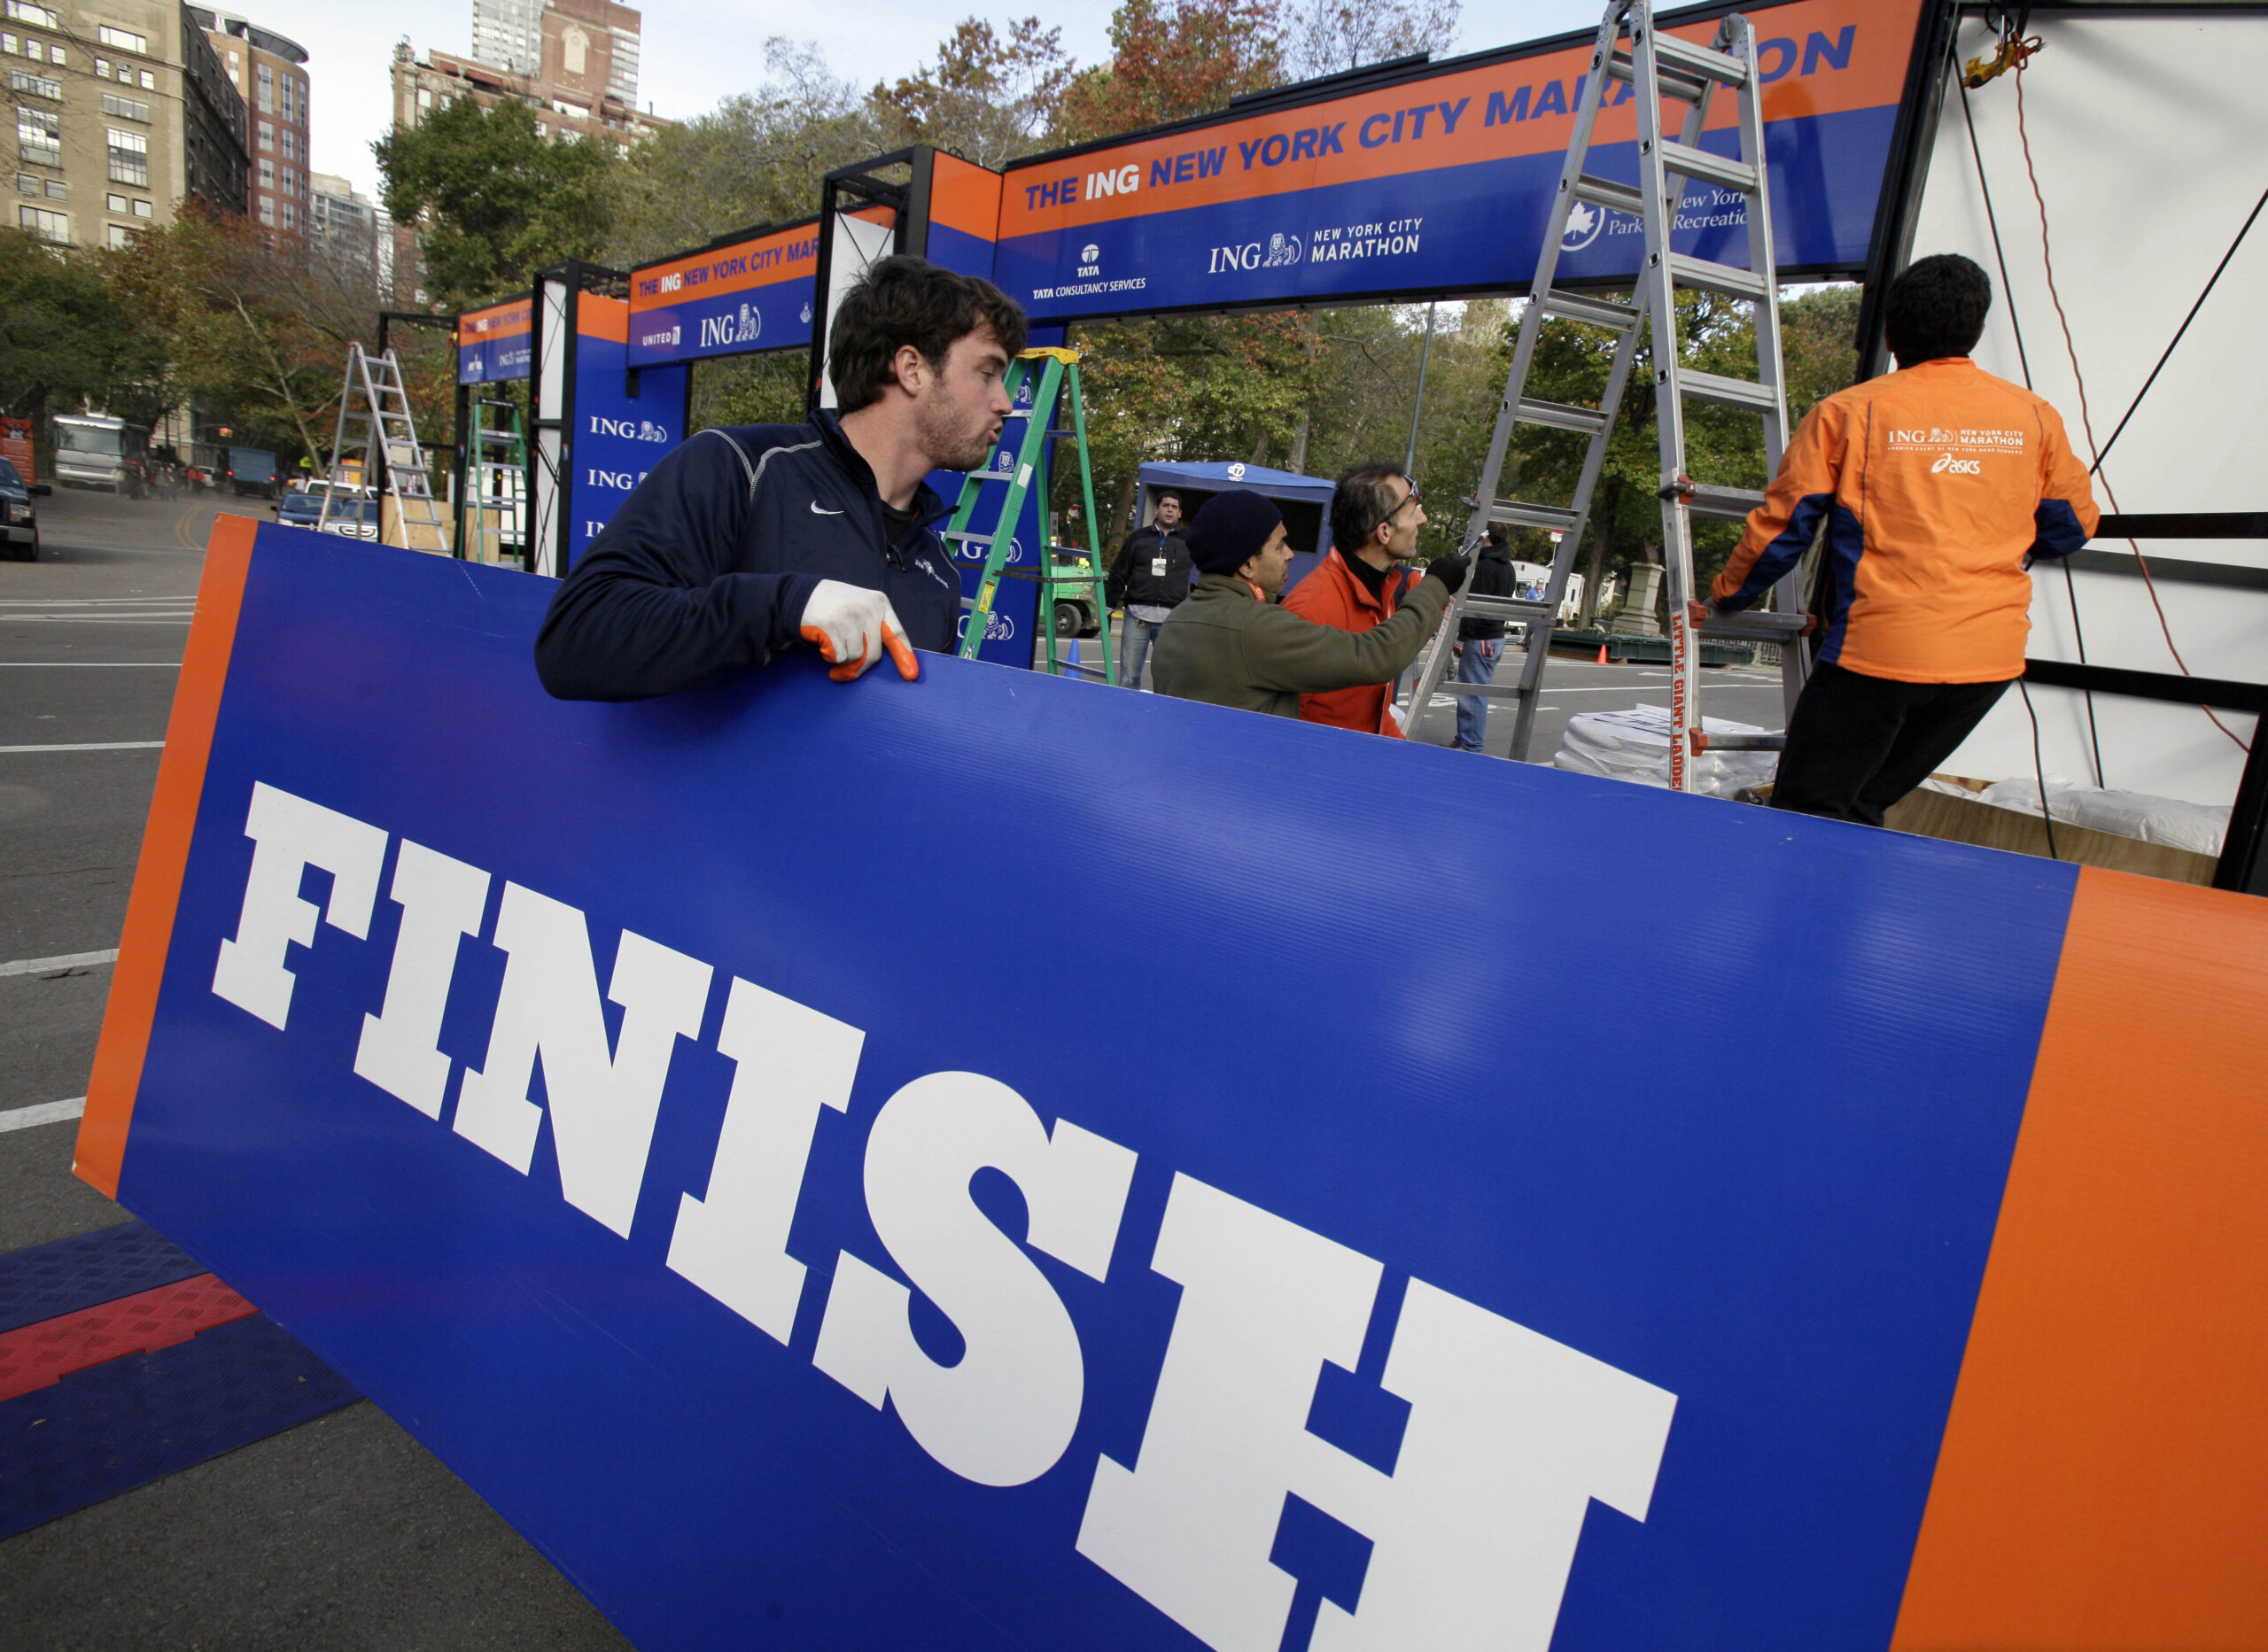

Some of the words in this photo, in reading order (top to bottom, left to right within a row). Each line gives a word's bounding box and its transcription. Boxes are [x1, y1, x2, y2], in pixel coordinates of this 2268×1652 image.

[1025, 177, 1078, 211] THE
[1085, 164, 1140, 201] ING
[1149, 145, 1227, 187] NEW
[1238, 121, 1347, 170] YORK
[1358, 97, 1472, 149] CITY
[1314, 228, 1341, 243] NEW
[1348, 222, 1383, 238] YORK
[1388, 218, 1423, 234] CITY
[1608, 217, 1644, 236] Park
[1208, 242, 1262, 274] ING
[1311, 234, 1420, 263] MARATHON
[639, 278, 659, 297] THE
[661, 273, 681, 293] ING
[683, 266, 709, 287] NEW
[712, 256, 748, 280] YORK
[750, 246, 783, 271] CITY
[1077, 265, 1099, 277] TATA
[1033, 288, 1053, 299] TATA
[1055, 282, 1108, 297] CONSULTANCY
[1109, 277, 1146, 291] SERVICES
[642, 332, 672, 345] UNITED
[700, 314, 734, 347] ING
[590, 415, 636, 439] ING
[1888, 430, 1926, 444] ING
[1960, 436, 2023, 446] MARATHON
[587, 469, 633, 490] ING
[1672, 614, 1685, 674] LITTLE
[1673, 679, 1685, 729] GIANT
[1672, 733, 1683, 791] LADDE
[211, 779, 1680, 1652] FINISH
